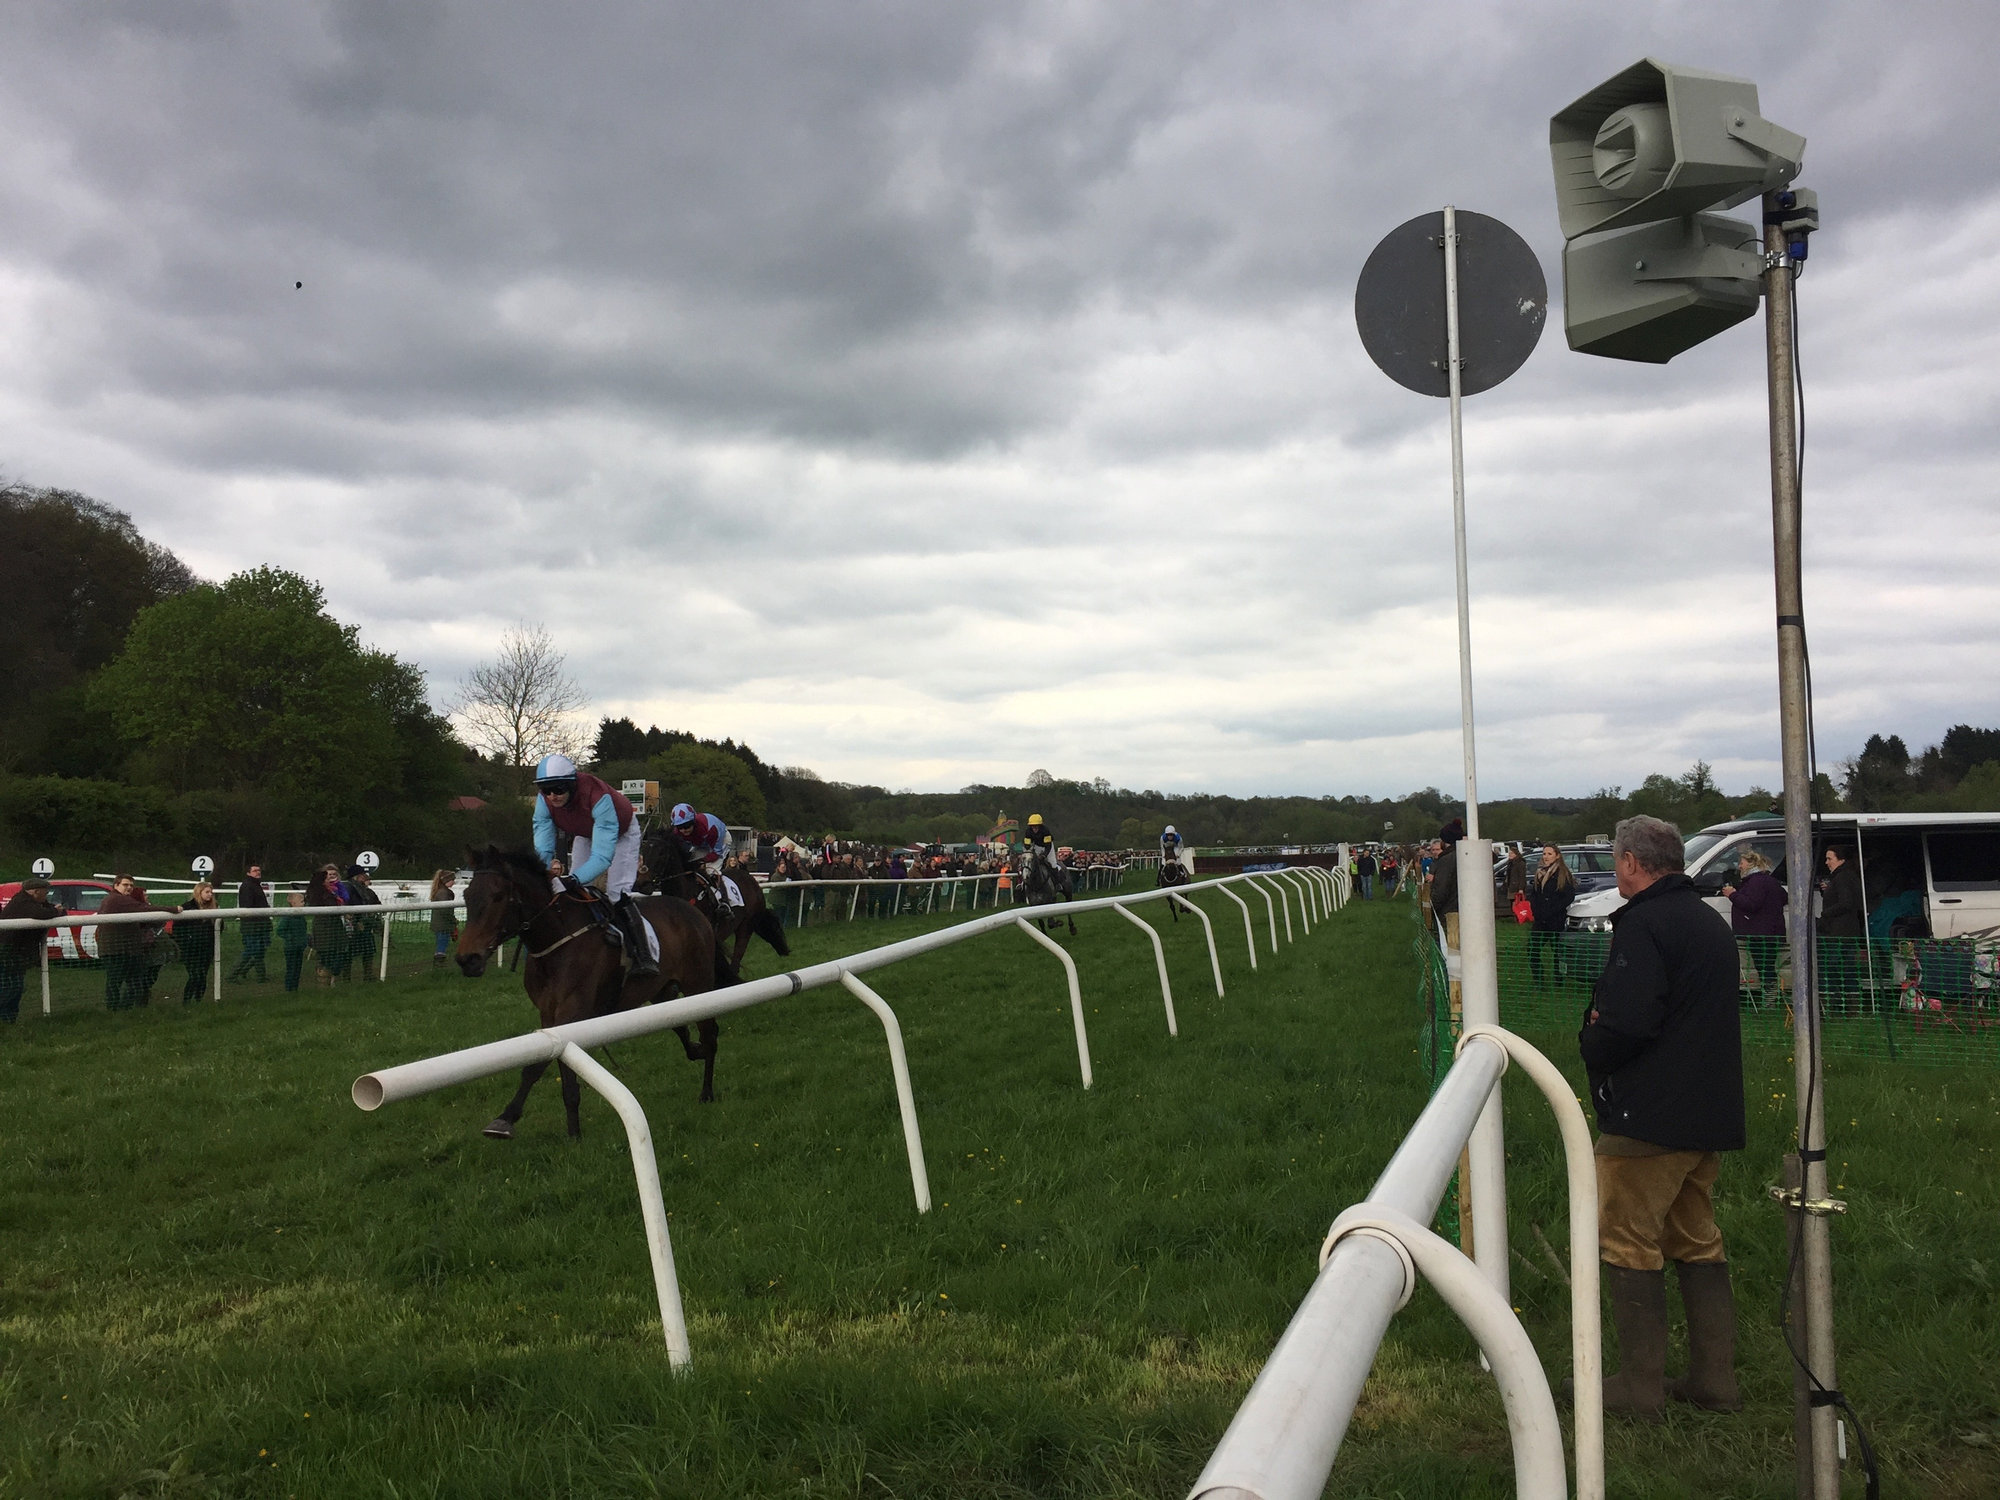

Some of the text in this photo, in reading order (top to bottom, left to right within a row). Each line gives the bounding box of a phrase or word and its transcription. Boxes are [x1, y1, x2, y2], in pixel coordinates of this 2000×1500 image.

[199, 858, 206, 869] 2
[363, 853, 371, 865] 3
[39, 860, 44, 871] 1
